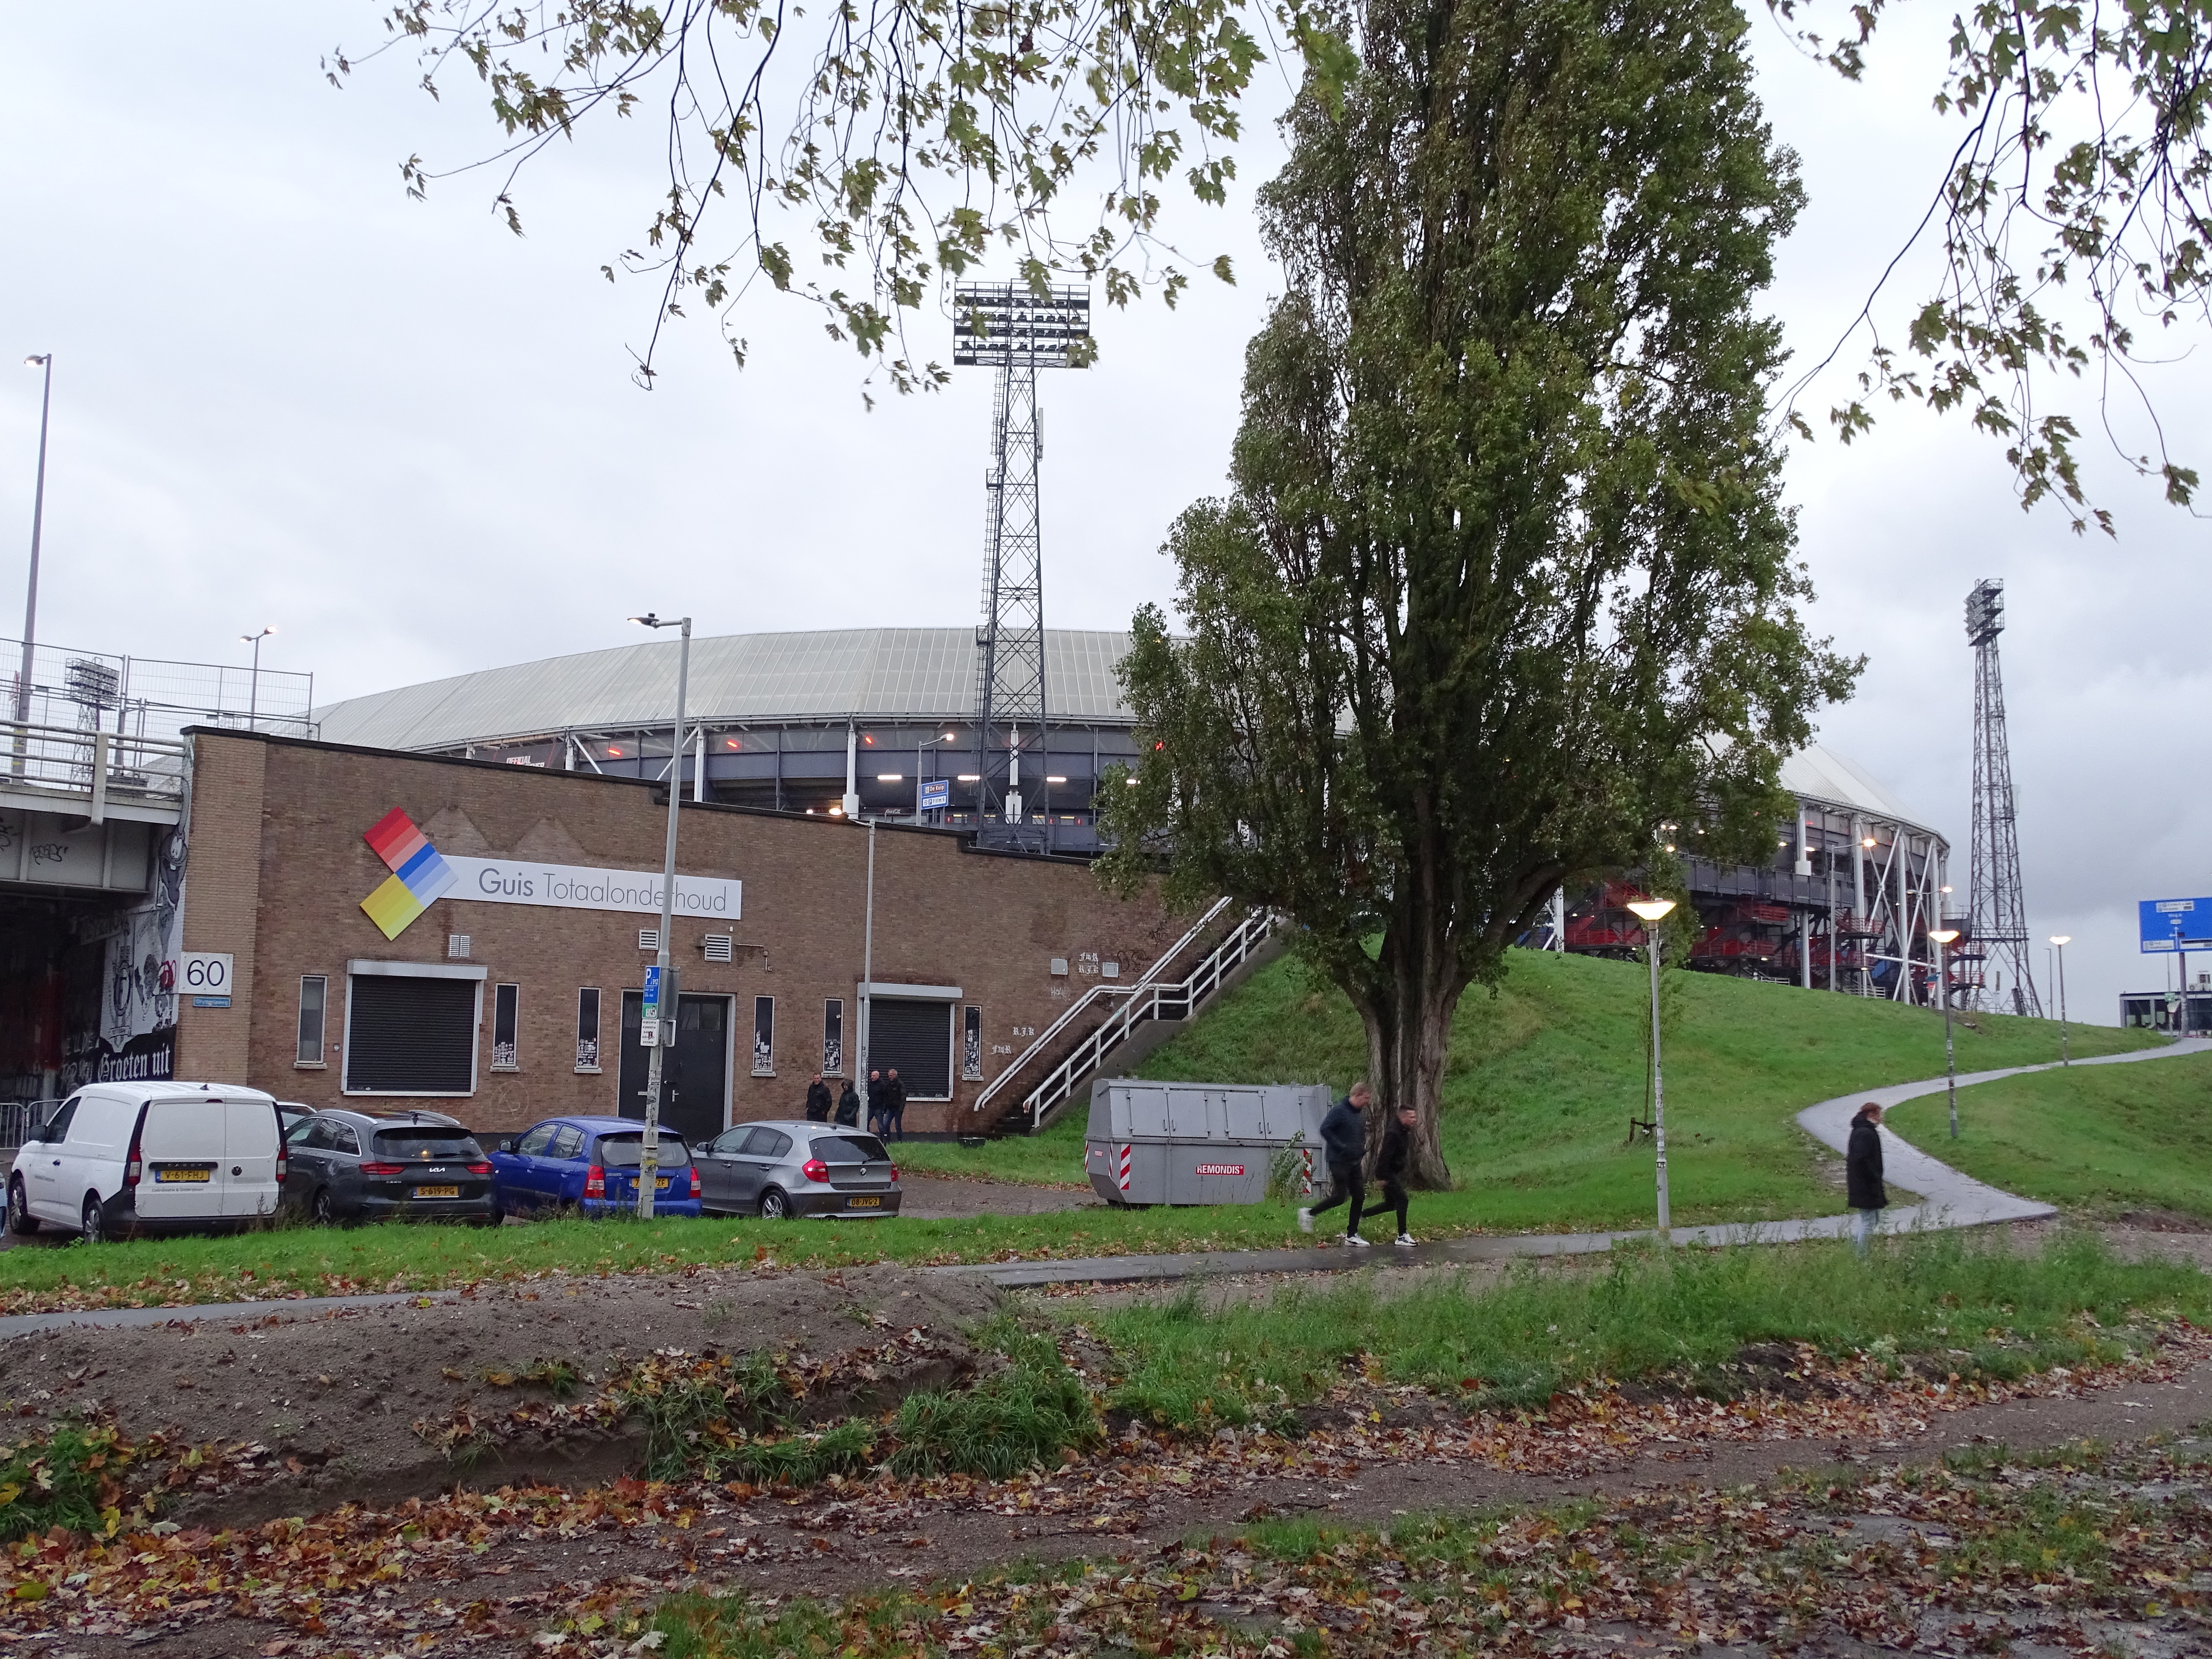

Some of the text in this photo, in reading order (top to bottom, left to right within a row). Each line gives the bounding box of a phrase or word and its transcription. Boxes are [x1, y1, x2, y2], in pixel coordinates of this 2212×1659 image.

[479, 868, 726, 911] Guis Totaalondehoud
[187, 960, 224, 987] 60
[645, 968, 652, 985] P
[98, 1052, 148, 1083] Groeten
[152, 1043, 170, 1076] uit
[165, 1171, 204, 1179] V-61-FHJ
